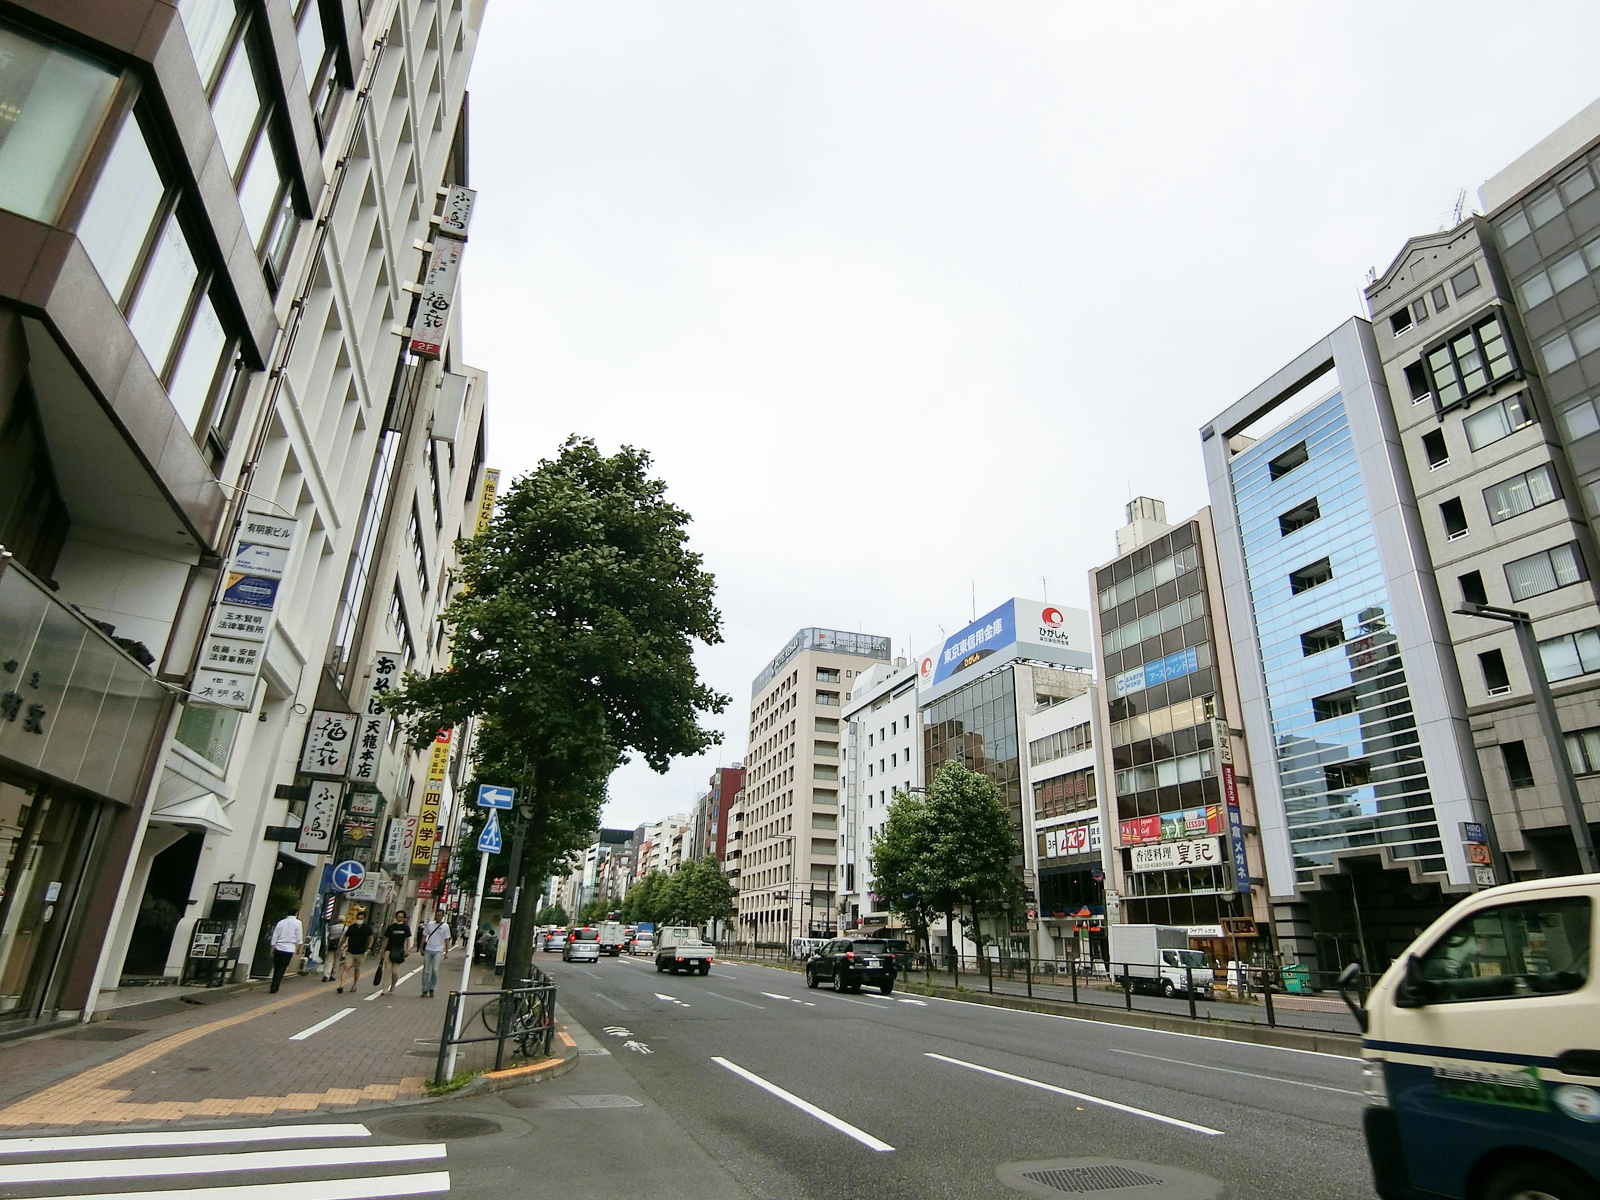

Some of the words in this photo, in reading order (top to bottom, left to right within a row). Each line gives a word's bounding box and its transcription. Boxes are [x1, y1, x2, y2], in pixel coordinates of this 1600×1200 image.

[418, 342, 435, 350] 2F
[247, 523, 291, 538] 有明家ビル
[218, 621, 264, 634] 法律事務所
[1039, 627, 1069, 640] ひがしん
[943, 618, 1003, 665] 東京東信用金庫
[212, 644, 257, 657] 佐藤・安部
[209, 653, 254, 665] 法律事務所
[963, 653, 981, 667] ひがしん
[1125, 671, 1143, 683] EARTH
[1148, 661, 1187, 682] アースウィンド
[1125, 680, 1141, 688] WIND
[199, 687, 245, 701] 有明家
[317, 717, 347, 766] 福の花
[356, 720, 381, 778] 天龍本店
[306, 787, 334, 840] ふくの鳥
[414, 792, 440, 859] 四谷学院
[1140, 818, 1152, 826] Japan
[1186, 819, 1205, 829] LESSON
[1466, 824, 1481, 833] HIRO
[404, 818, 416, 849] クスリ
[1230, 811, 1247, 879] 朝倉メガネ
[1136, 846, 1173, 863] 香港料理
[1177, 843, 1213, 866] 皇記
